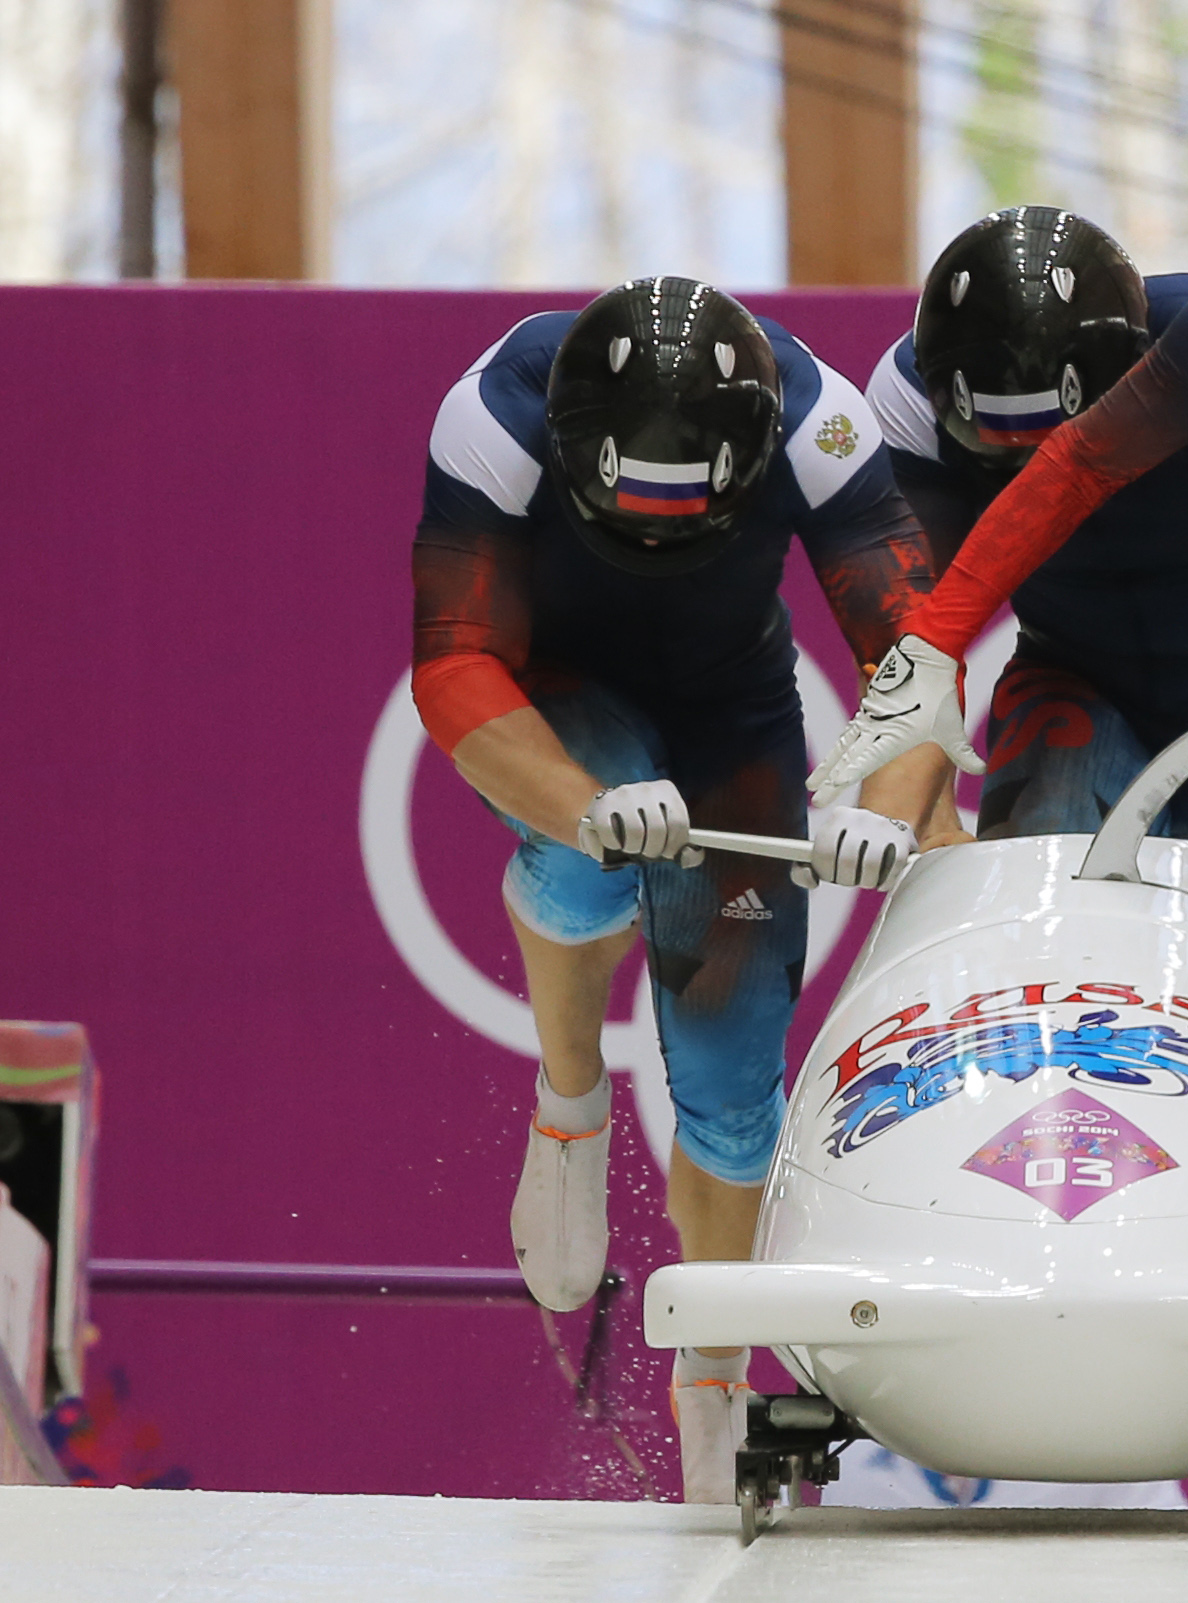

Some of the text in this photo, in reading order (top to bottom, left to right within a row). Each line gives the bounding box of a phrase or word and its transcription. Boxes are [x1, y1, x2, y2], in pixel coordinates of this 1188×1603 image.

[721, 906, 774, 920] adidas
[1022, 1125, 1119, 1137] SOCHI 2014
[1024, 1156, 1114, 1189] 03
